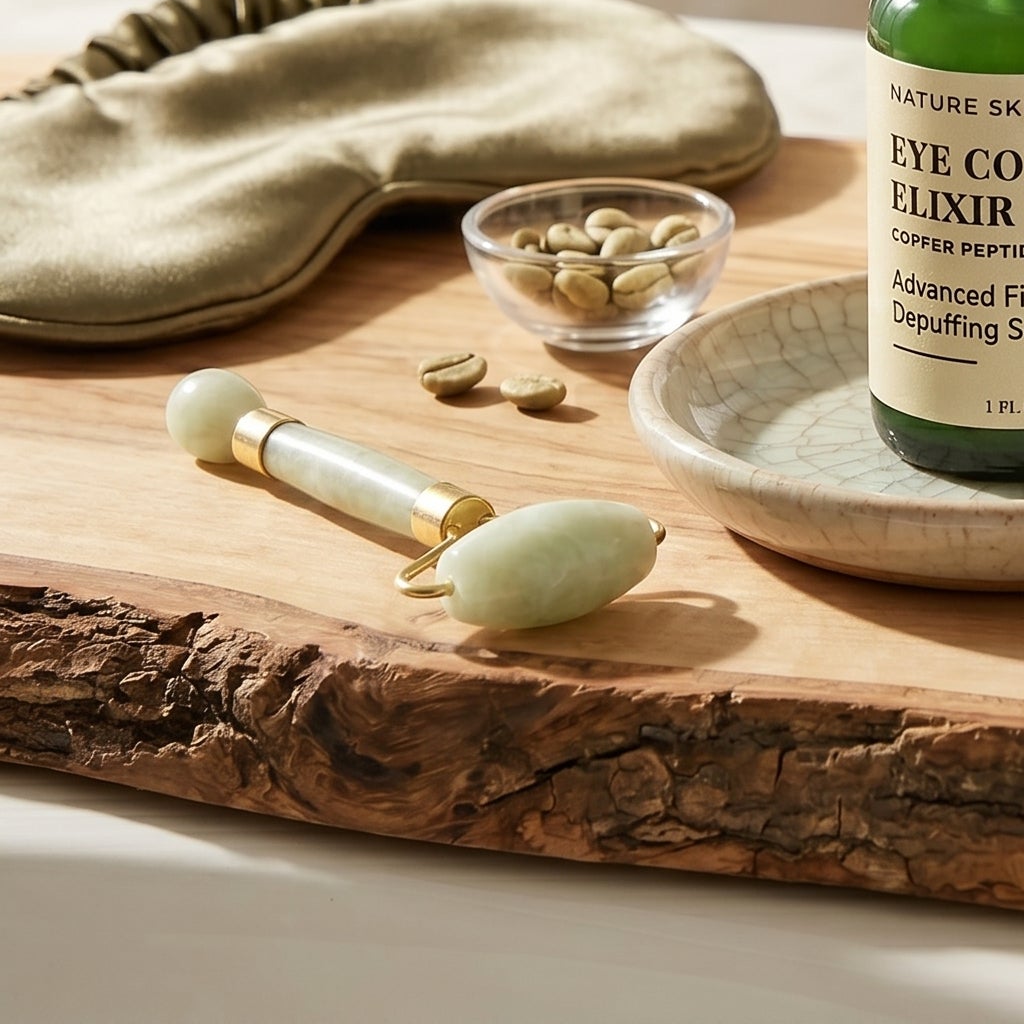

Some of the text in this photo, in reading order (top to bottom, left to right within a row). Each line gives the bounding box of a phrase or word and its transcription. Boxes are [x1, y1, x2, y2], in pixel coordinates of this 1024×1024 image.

[892, 84, 978, 115] NATURE
[891, 134, 951, 176] EYE
[892, 179, 1015, 226] ELIXIR
[893, 270, 994, 307] Advanced
[893, 300, 998, 345] Depuffing
[986, 400, 992, 413] 1
